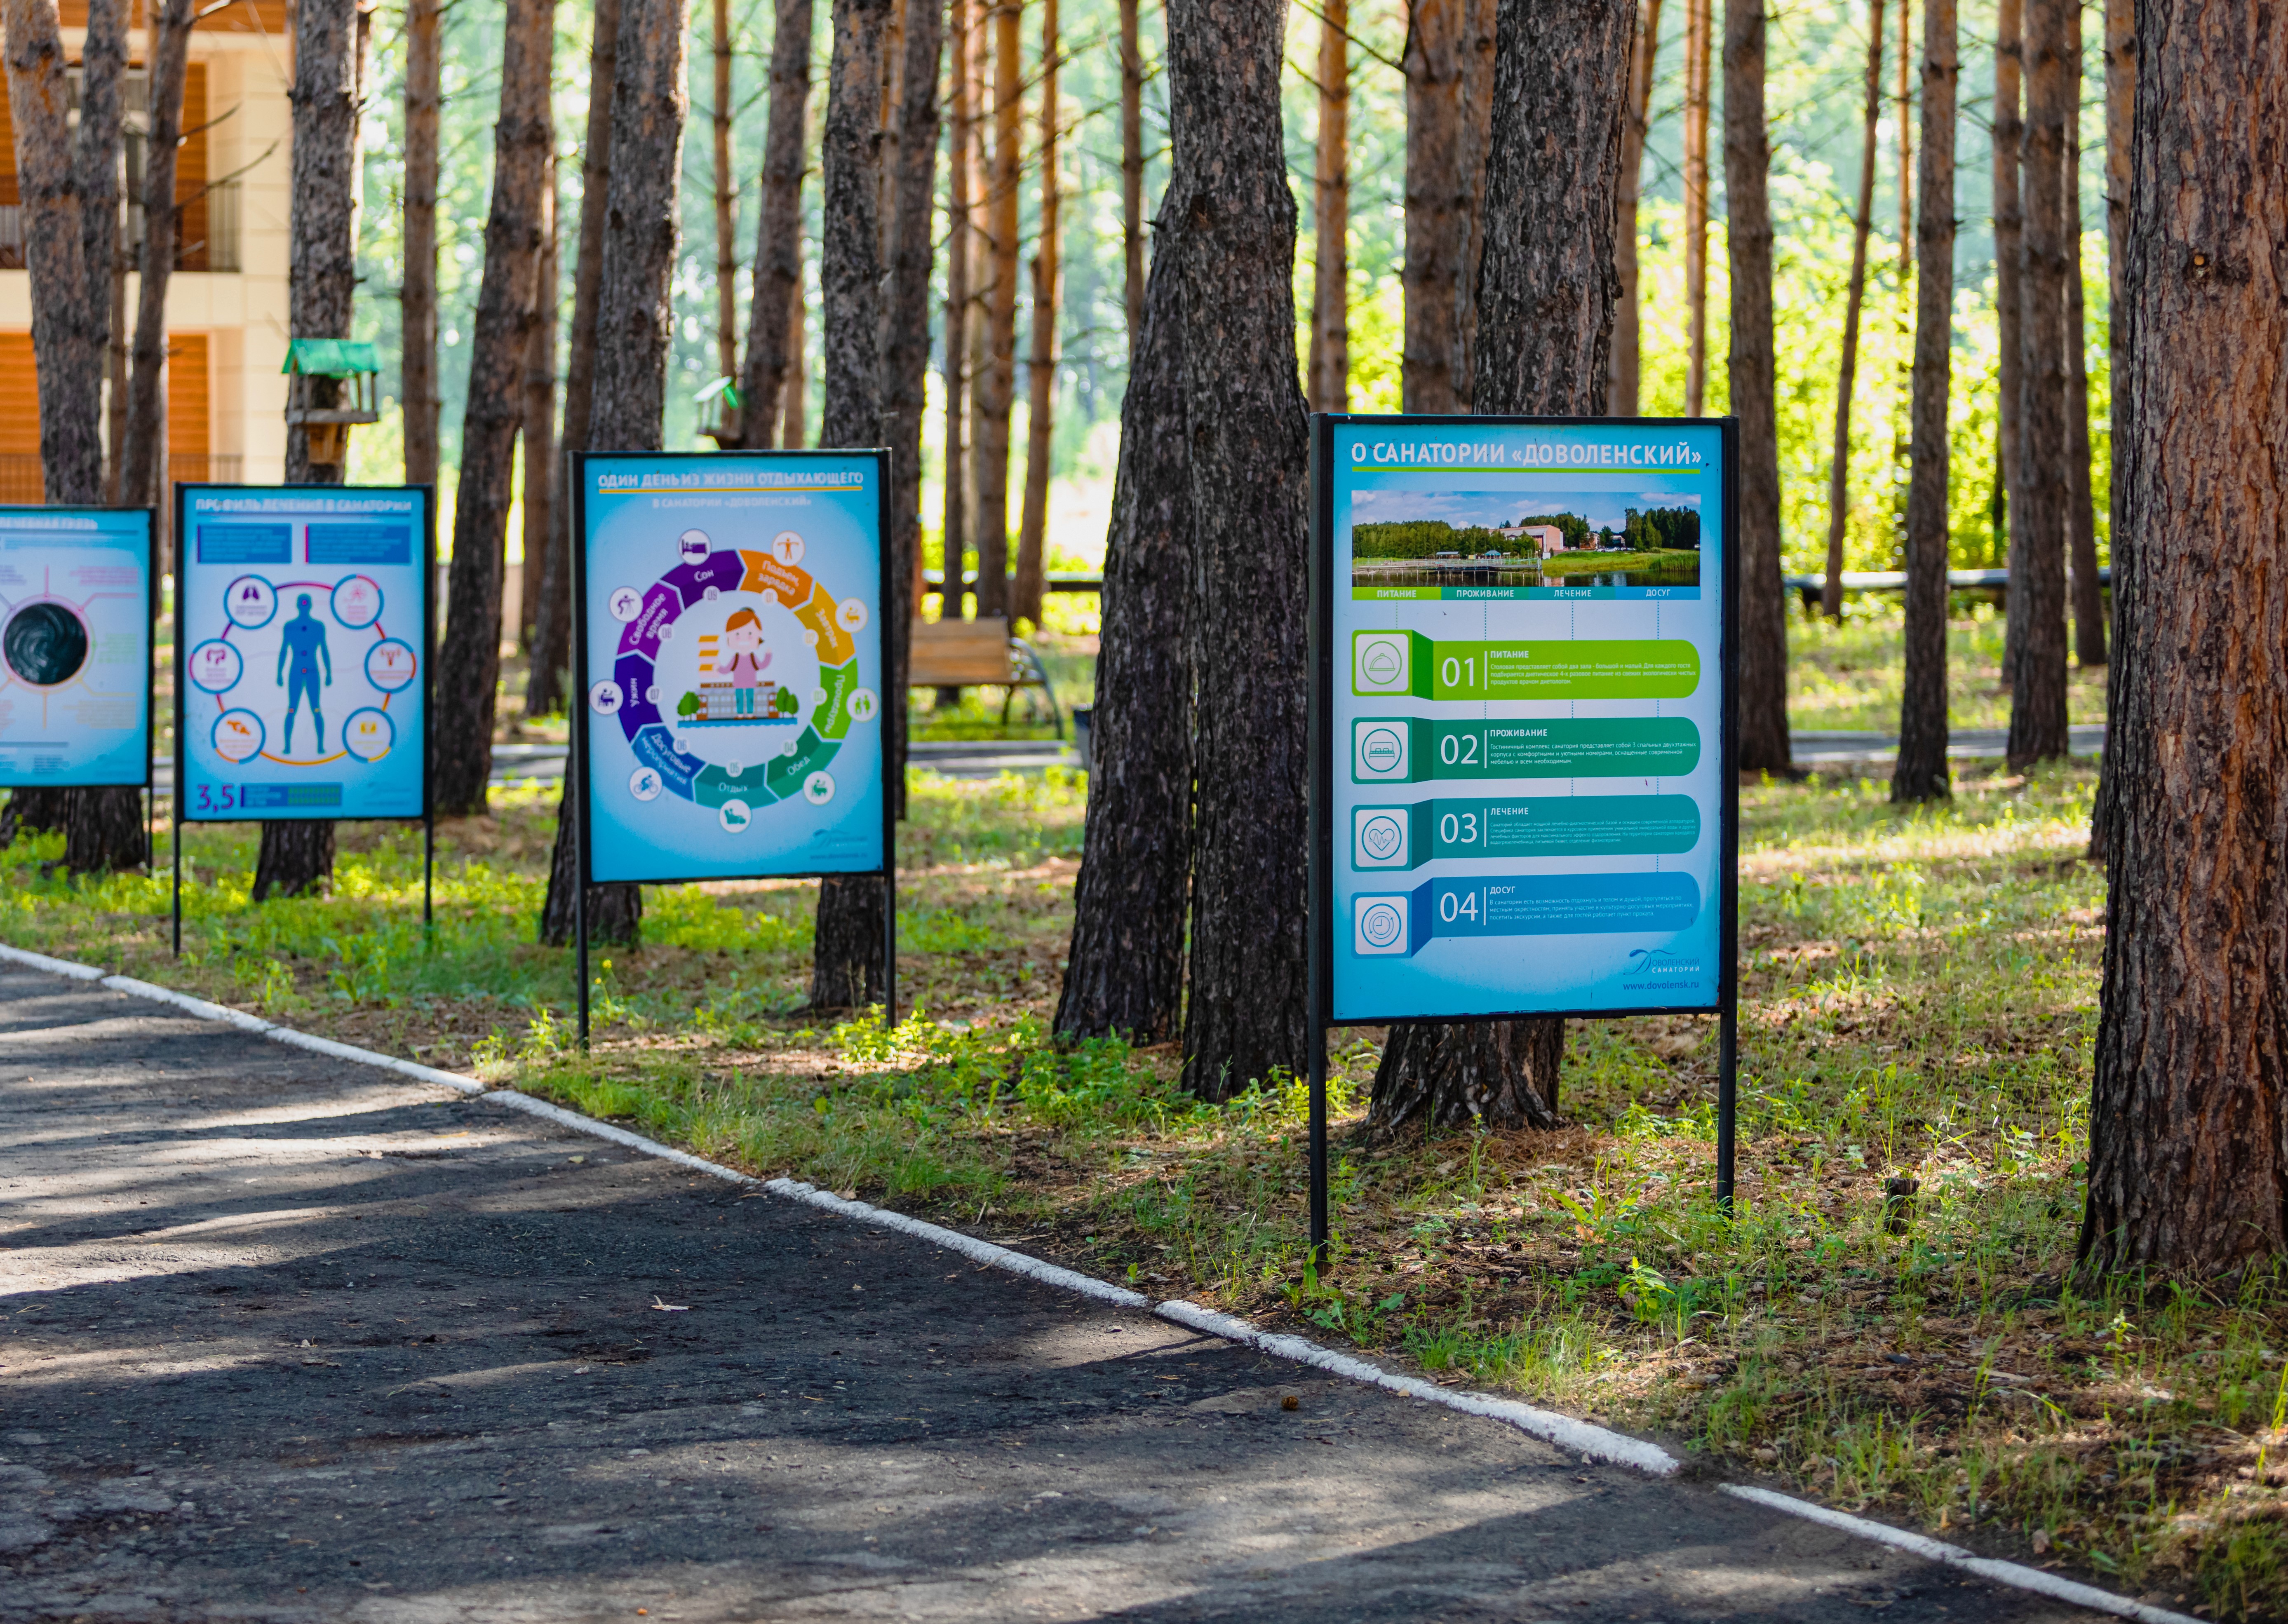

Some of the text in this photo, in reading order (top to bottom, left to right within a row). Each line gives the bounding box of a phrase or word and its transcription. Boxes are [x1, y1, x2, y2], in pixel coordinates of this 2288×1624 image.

[1351, 441, 1701, 466] О САНАТОРИИ «ДОВОЛЕНСКИЙ»
[598, 472, 863, 488] ОДИН ДЕНЬ ИЗ ЖИЗНИ ОТДЫХАЮЩЕГО
[693, 569, 714, 582] Сон
[758, 573, 795, 596] зарядка
[1377, 589, 1416, 598] ПИТАНИЕ
[1456, 589, 1514, 598] ПРОЖИВАНИЕ
[1646, 589, 1670, 597] ДОСУГ
[629, 593, 666, 645] Свободное
[646, 608, 668, 639] время
[1442, 657, 1474, 687] 01
[630, 678, 640, 708] Ужин
[1440, 734, 1478, 765] 02
[787, 756, 810, 775] Обед
[198, 784, 234, 812] 3,5
[1440, 813, 1477, 843] 03
[1490, 886, 1515, 895] ДОСУГ
[1440, 892, 1478, 922] 04
[1623, 981, 1699, 990] www.dovolensk.ru
